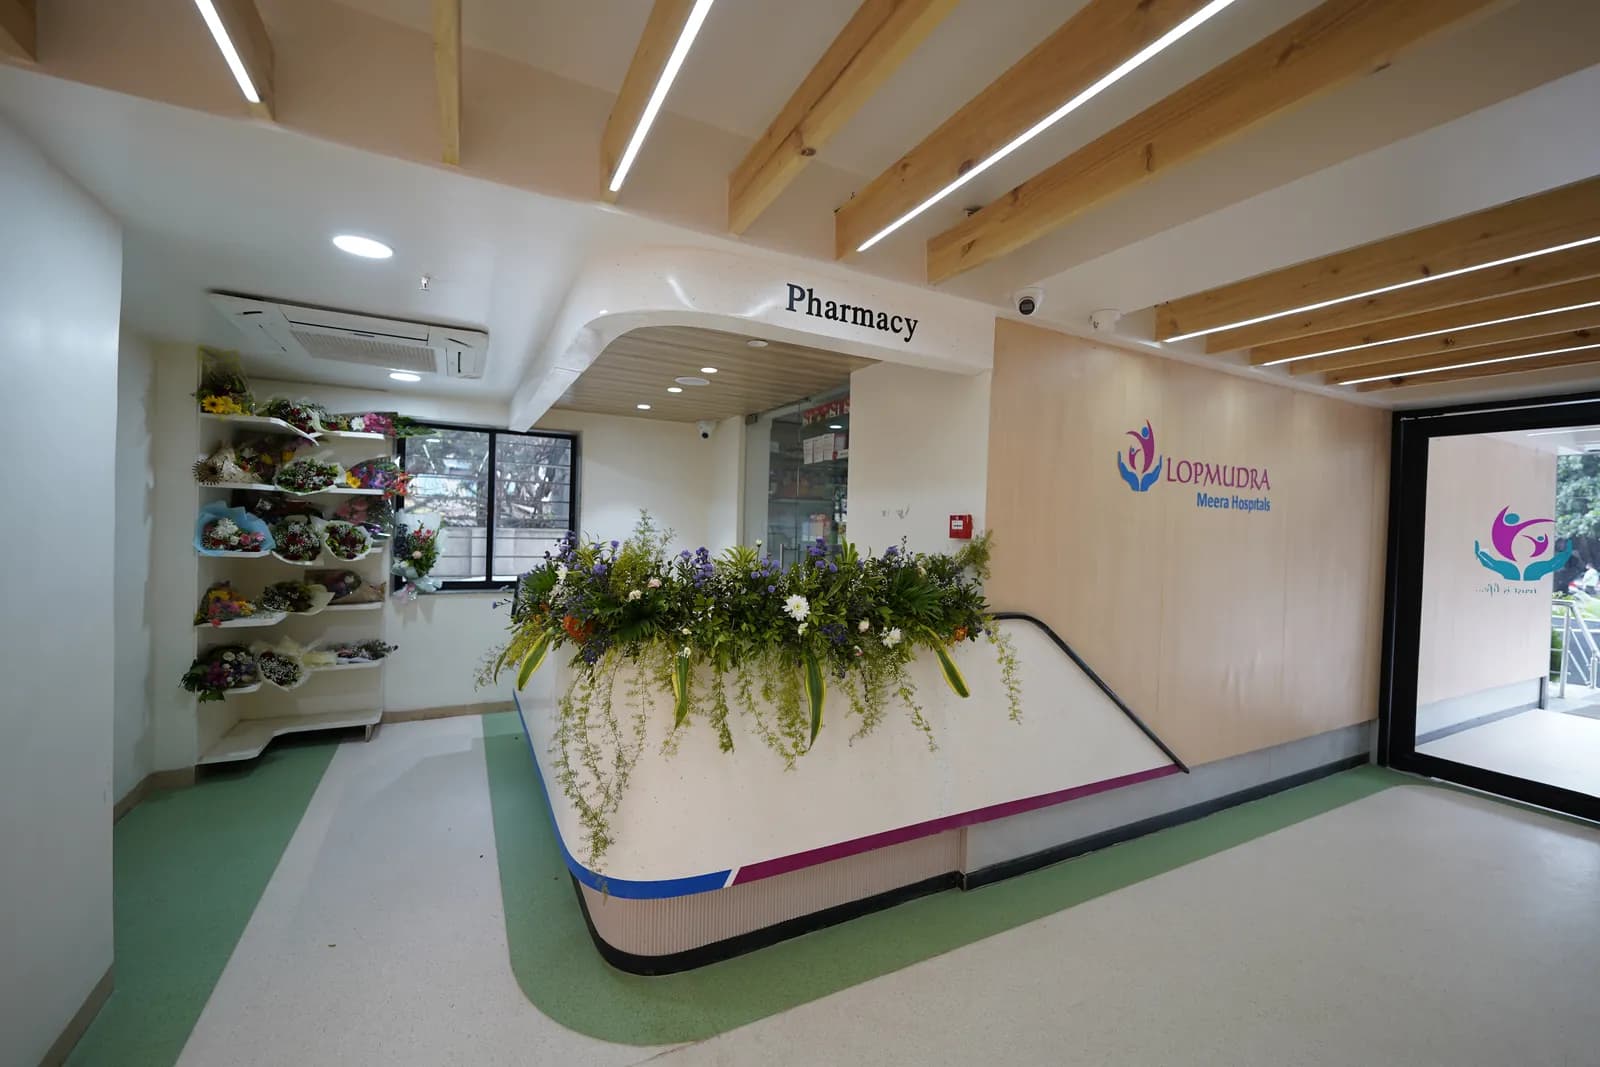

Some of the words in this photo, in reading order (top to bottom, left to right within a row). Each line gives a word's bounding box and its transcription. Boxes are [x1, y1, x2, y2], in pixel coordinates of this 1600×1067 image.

[785, 282, 919, 342] Pharmacy
[1167, 457, 1271, 491] LOPMUDRA
[1196, 492, 1229, 509] Meera
[1231, 495, 1271, 513] Hospitals
